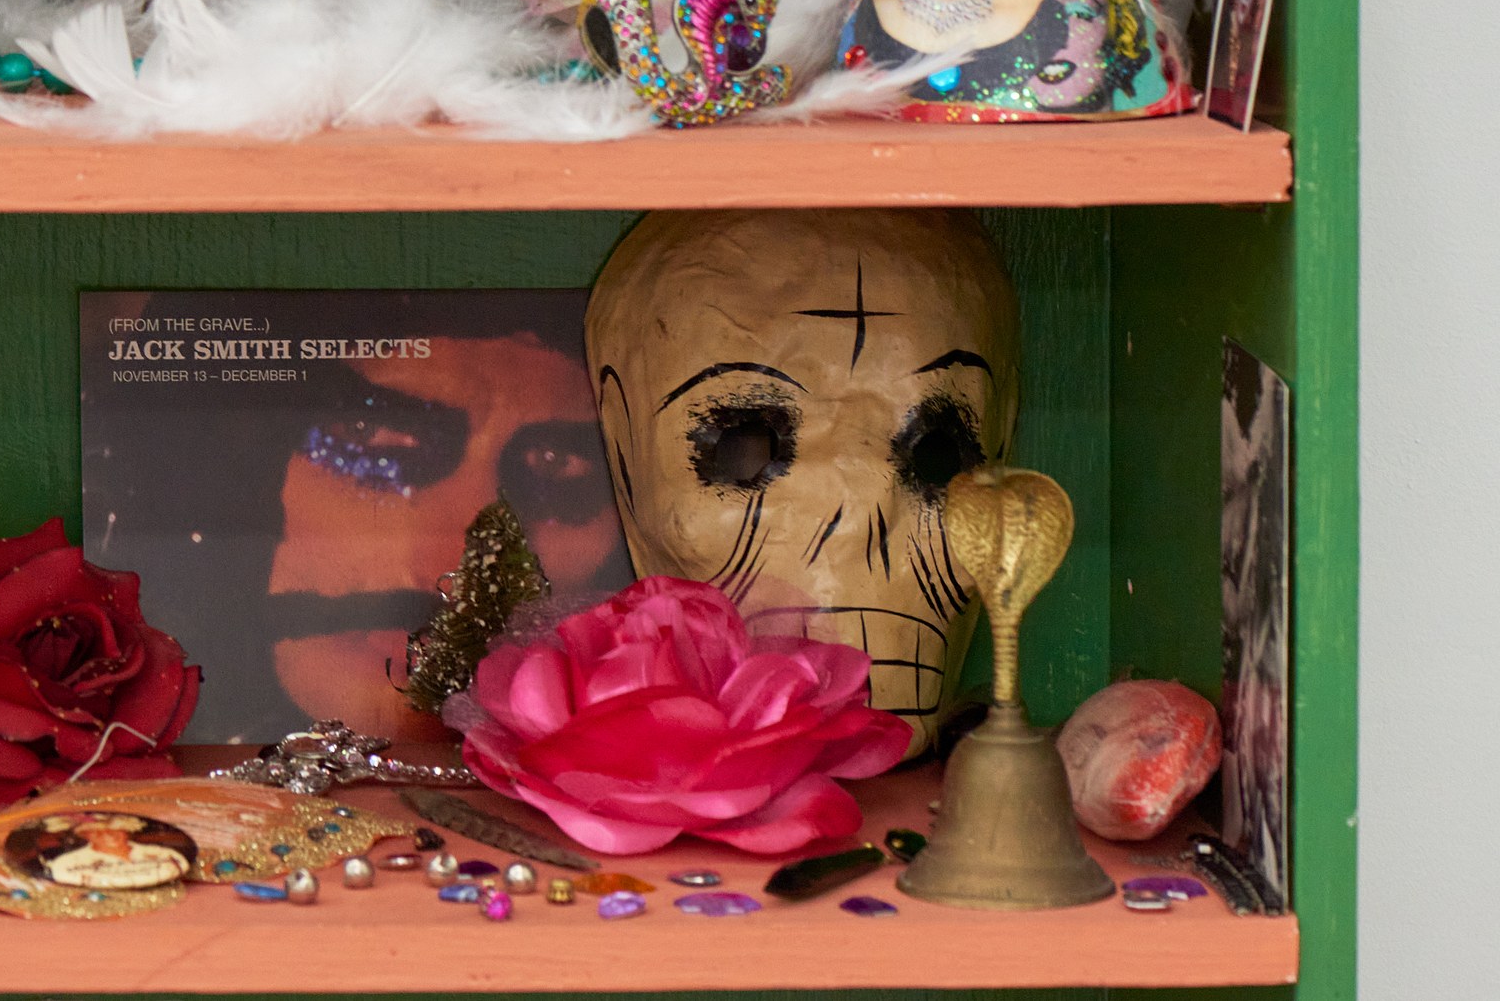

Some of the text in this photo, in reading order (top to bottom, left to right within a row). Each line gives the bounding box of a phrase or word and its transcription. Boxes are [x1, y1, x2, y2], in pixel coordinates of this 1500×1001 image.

[108, 317, 271, 334] (FROM THE GRAVE...)
[108, 338, 432, 361] JACK SMITH SELECTS
[112, 370, 189, 383] NOVEMBER
[193, 370, 207, 382] 13
[221, 369, 297, 382] DECEMBER
[301, 370, 307, 381] 1
